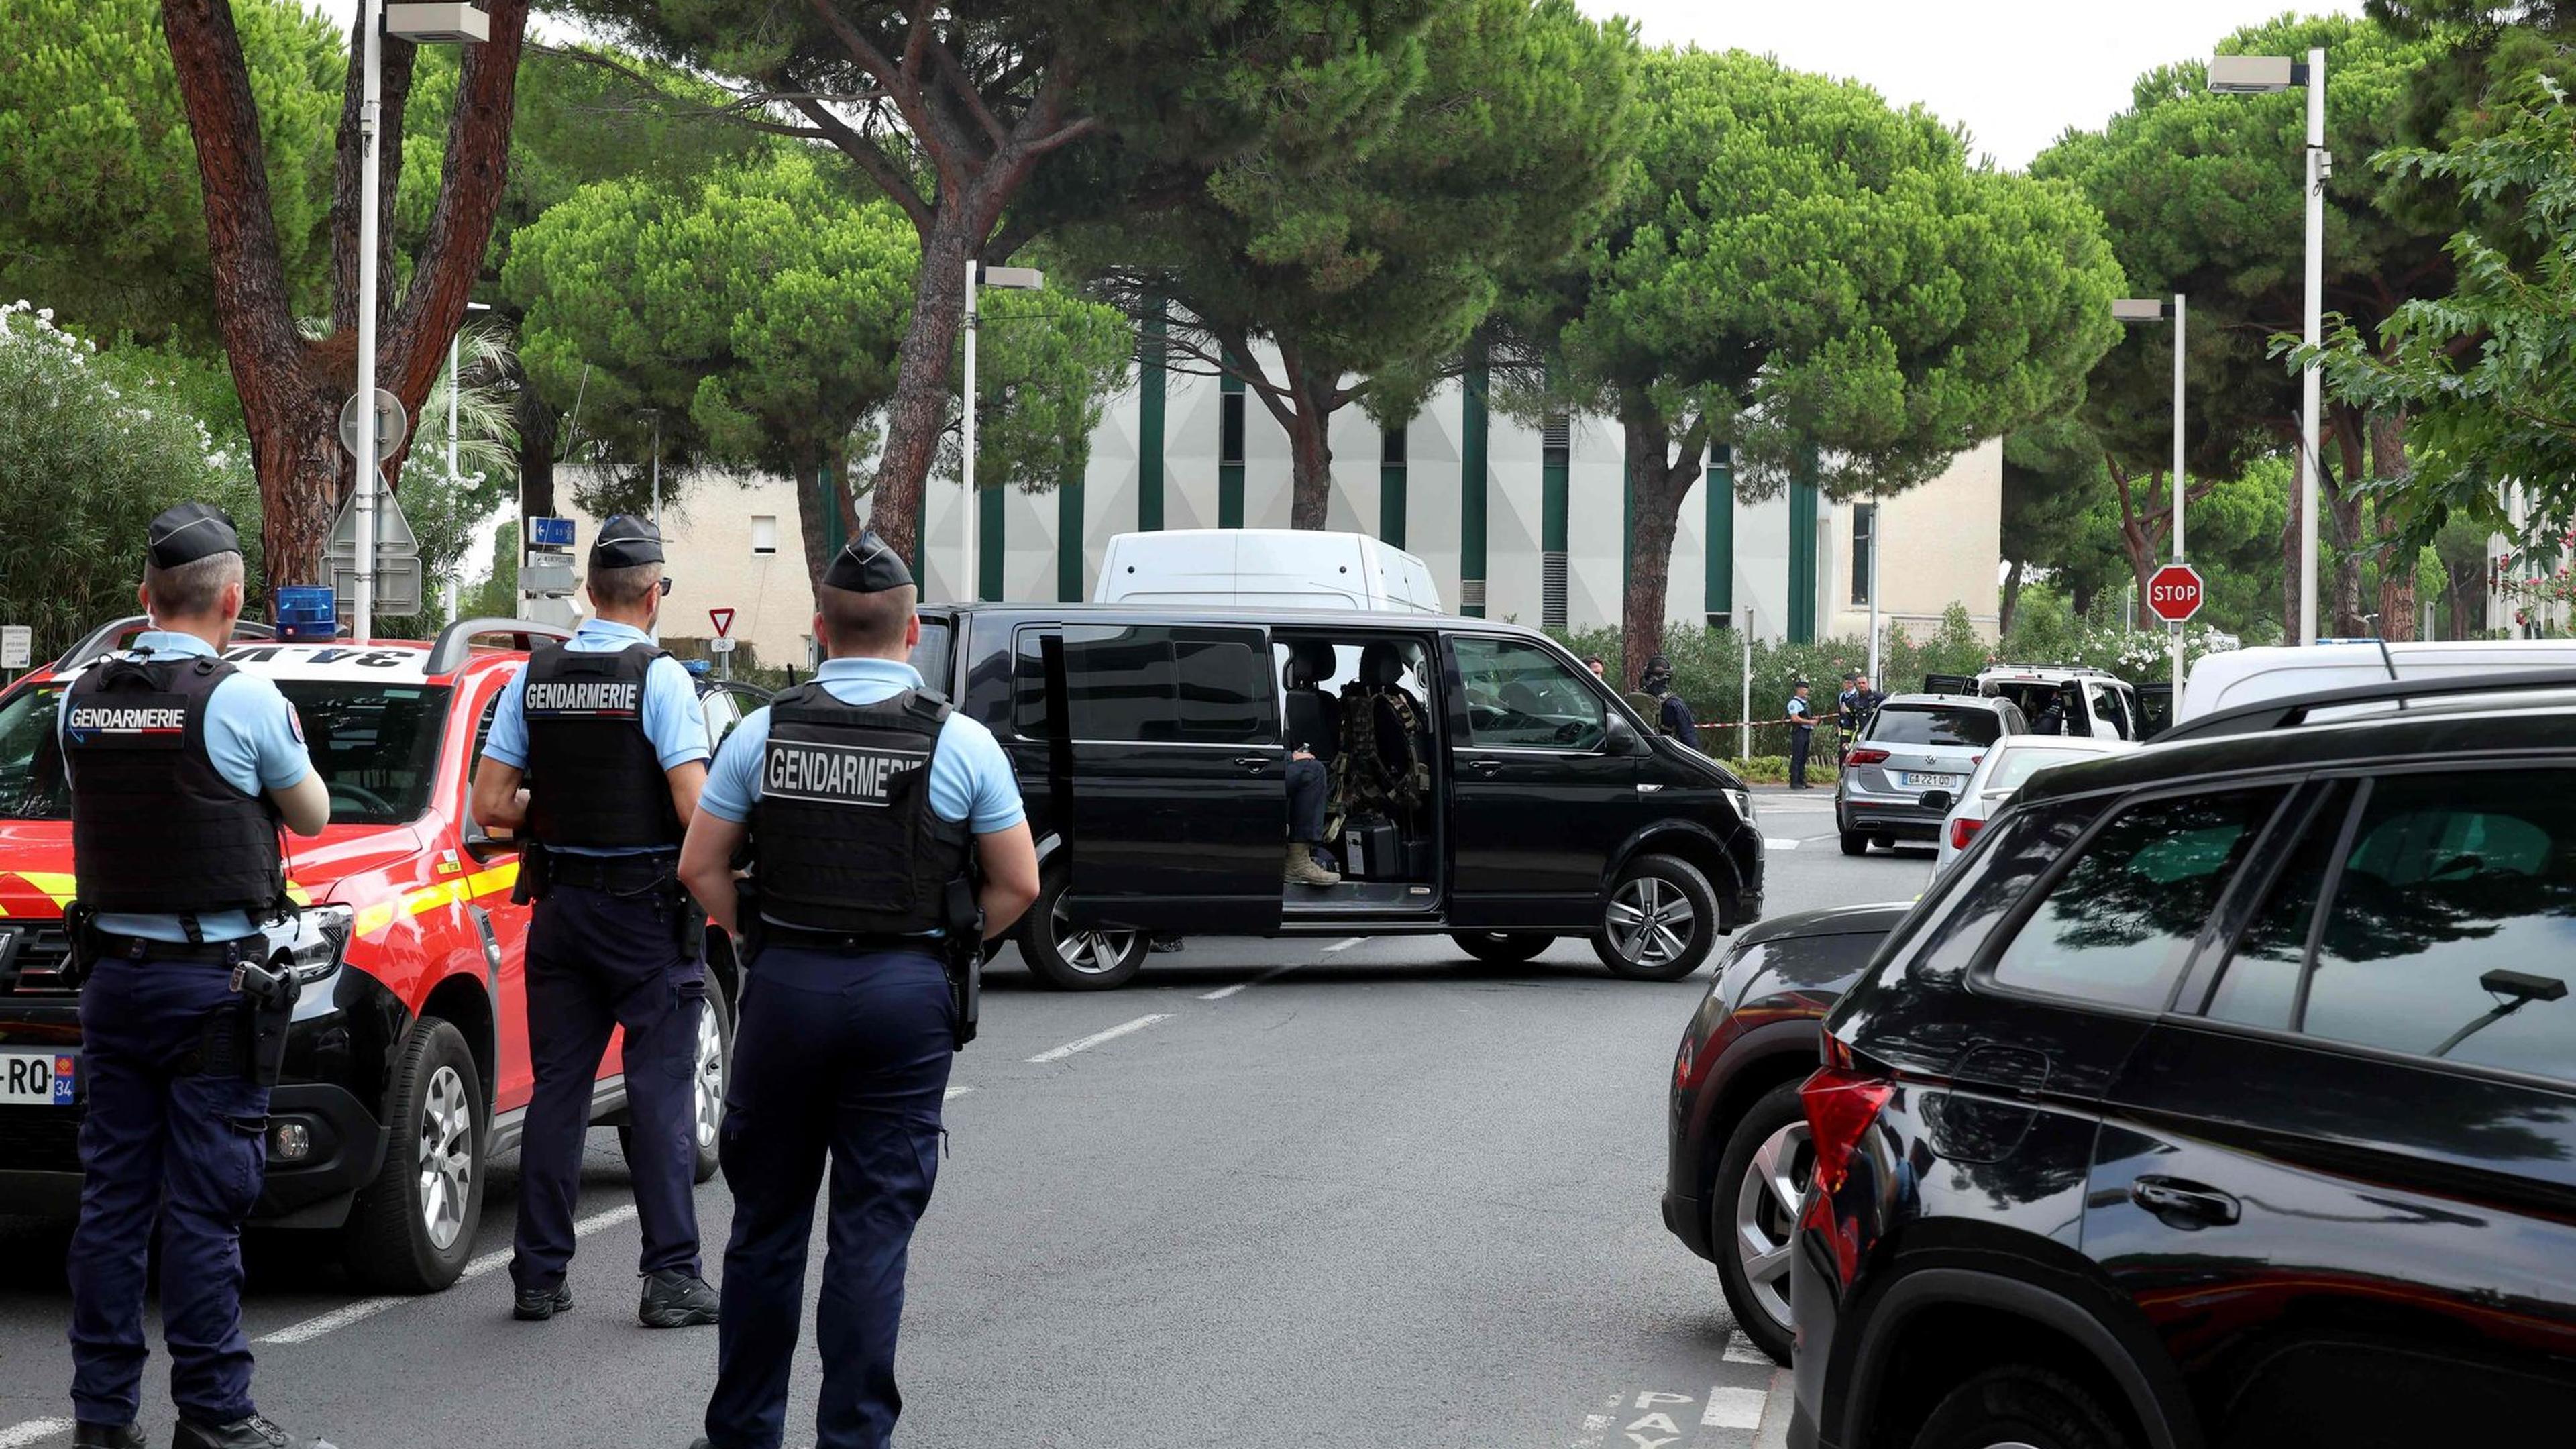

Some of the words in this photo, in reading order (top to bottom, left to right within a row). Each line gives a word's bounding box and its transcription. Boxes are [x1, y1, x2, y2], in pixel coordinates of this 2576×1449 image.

[2154, 585, 2196, 602] STOP
[526, 683, 637, 710] GENDARMERIE
[71, 708, 185, 728] GENDARMERIE
[770, 747, 923, 798] GENDARME
[56, 1080, 72, 1096] 34
